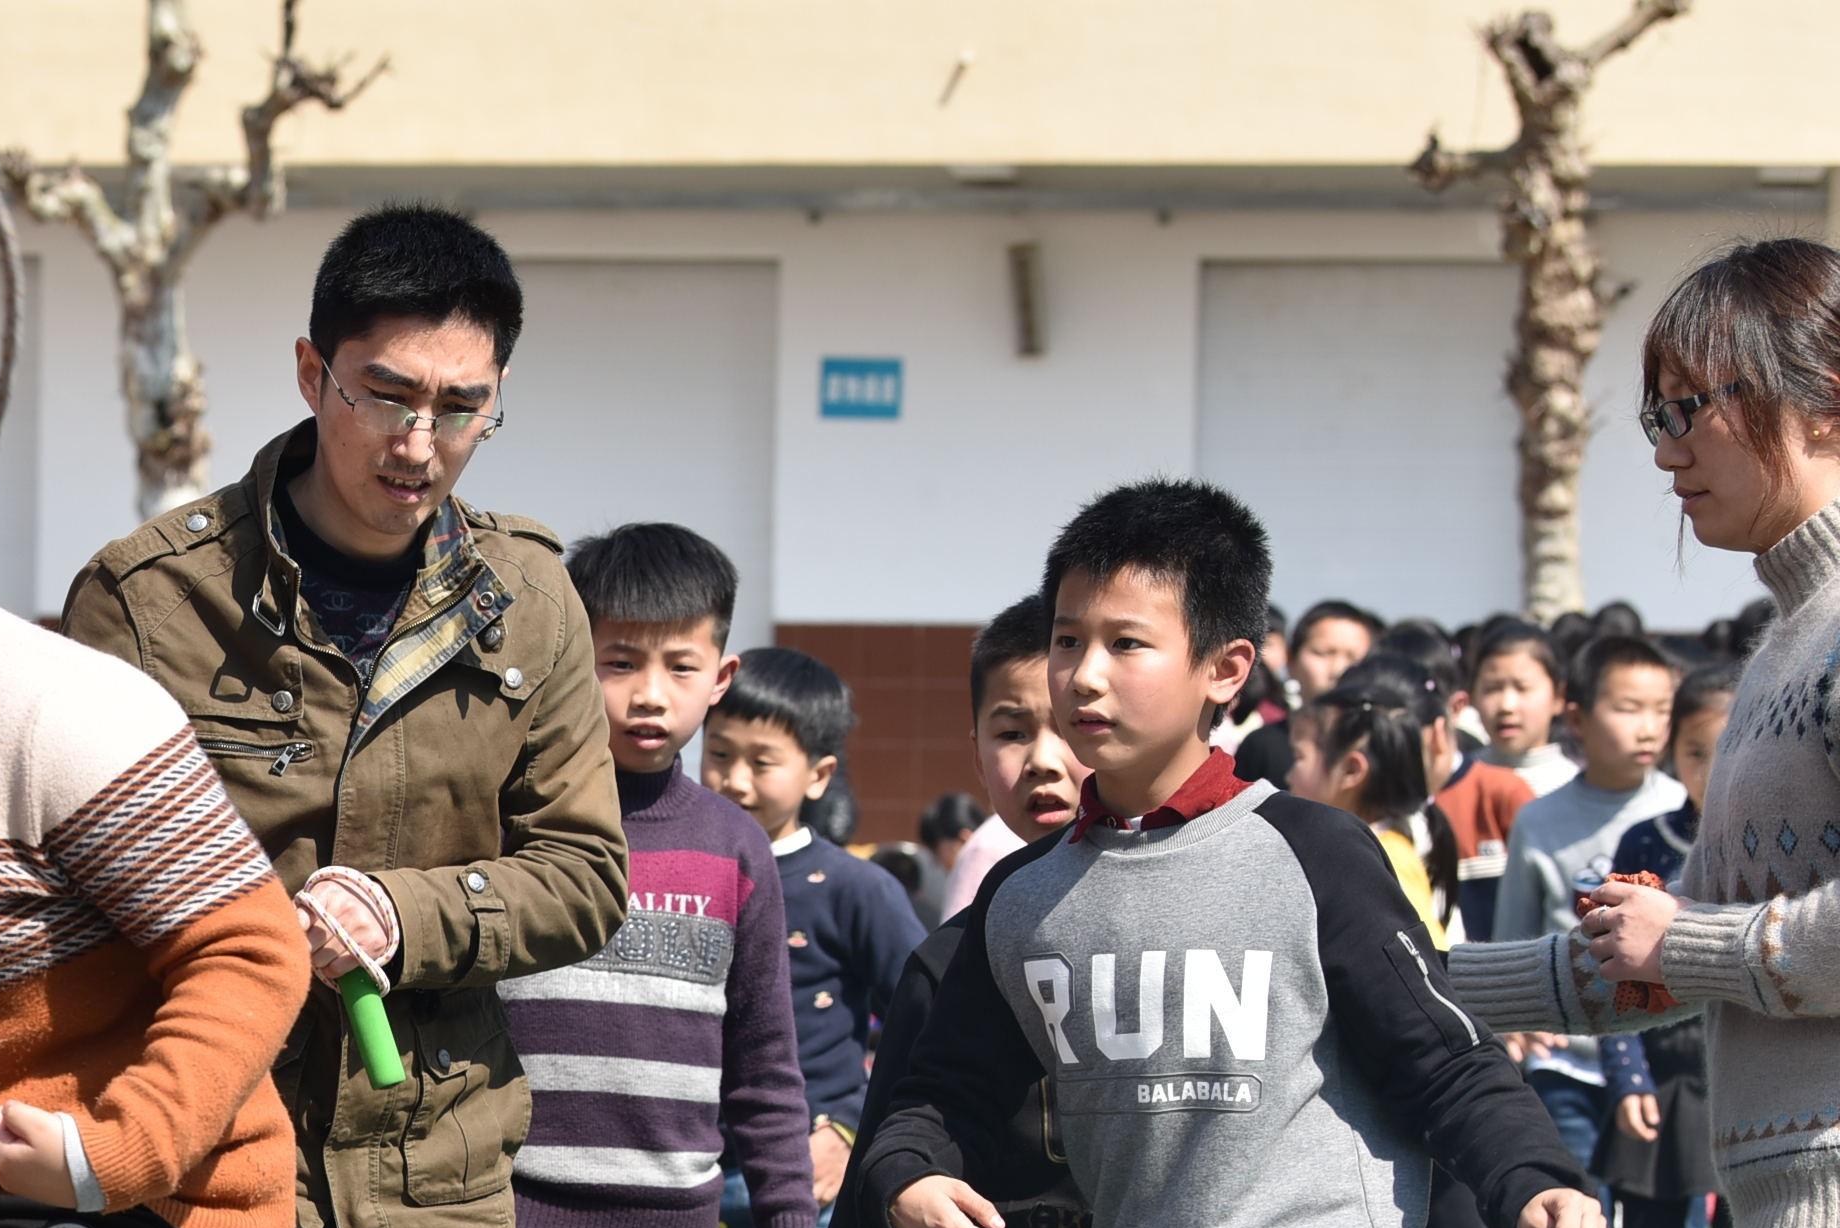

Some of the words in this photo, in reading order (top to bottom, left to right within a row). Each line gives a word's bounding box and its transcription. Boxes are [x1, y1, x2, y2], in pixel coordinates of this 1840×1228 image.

[591, 916, 731, 973] OLF
[1023, 949, 1274, 1064] RUN
[1137, 1080, 1252, 1104] BALABALA
